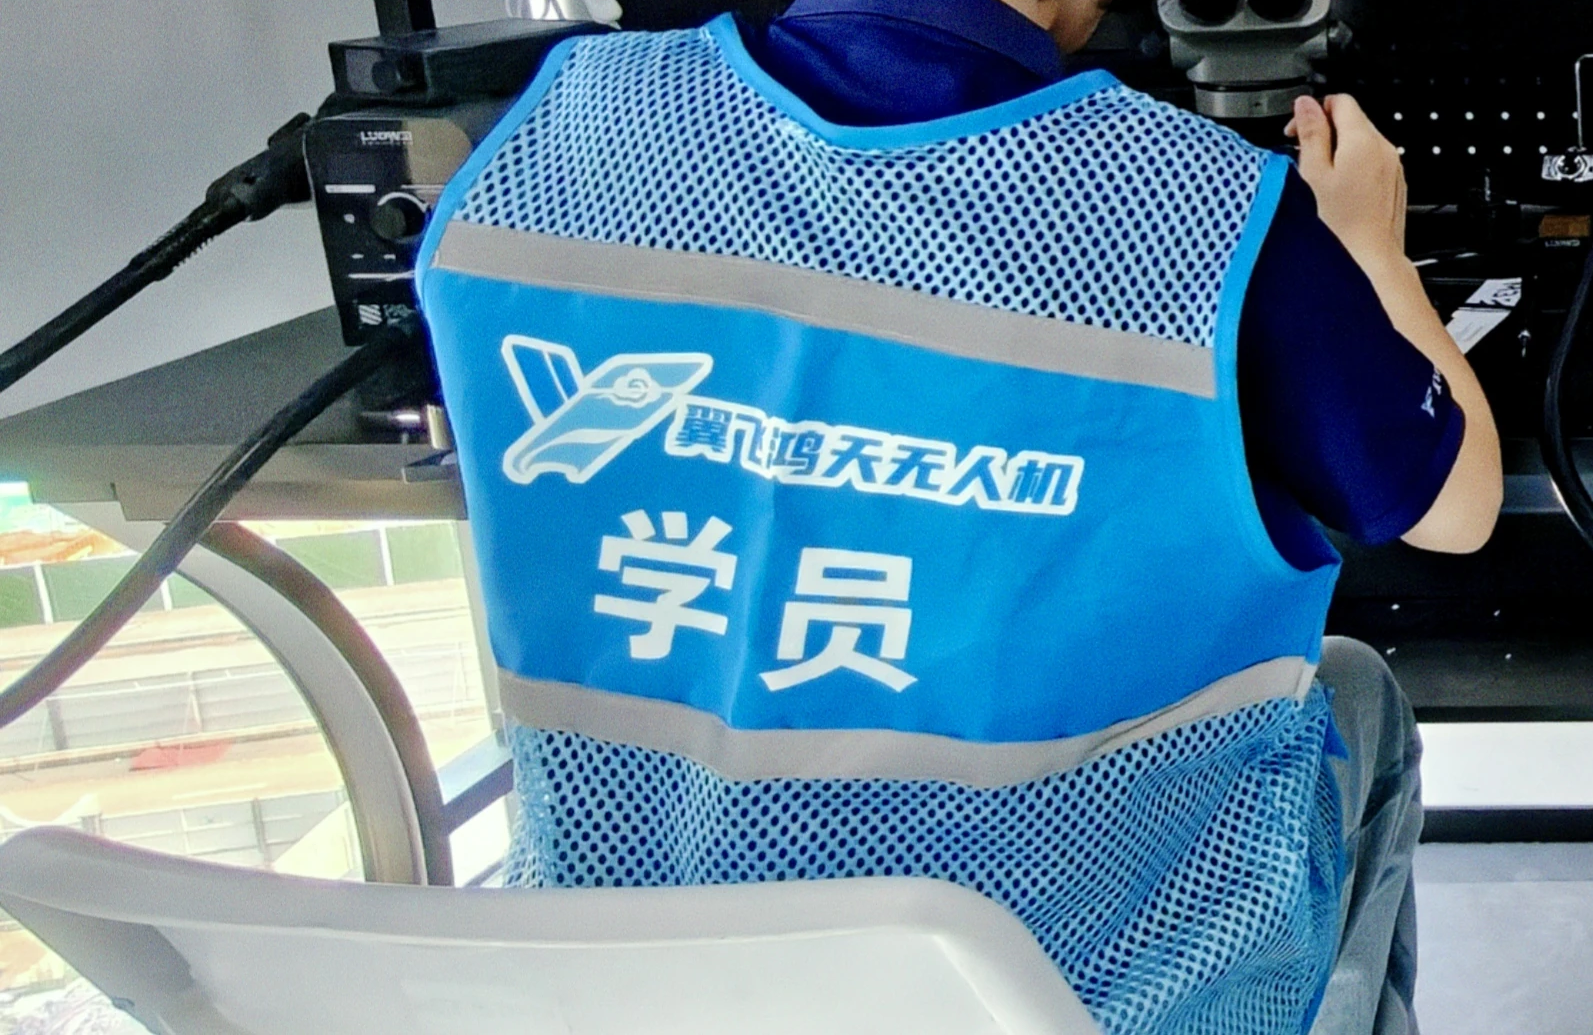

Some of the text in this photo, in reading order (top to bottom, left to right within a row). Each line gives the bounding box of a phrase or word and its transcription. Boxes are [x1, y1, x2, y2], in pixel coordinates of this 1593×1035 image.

[669, 399, 1081, 512] 翼飞鸿天无人机
[594, 509, 918, 692] 学员
